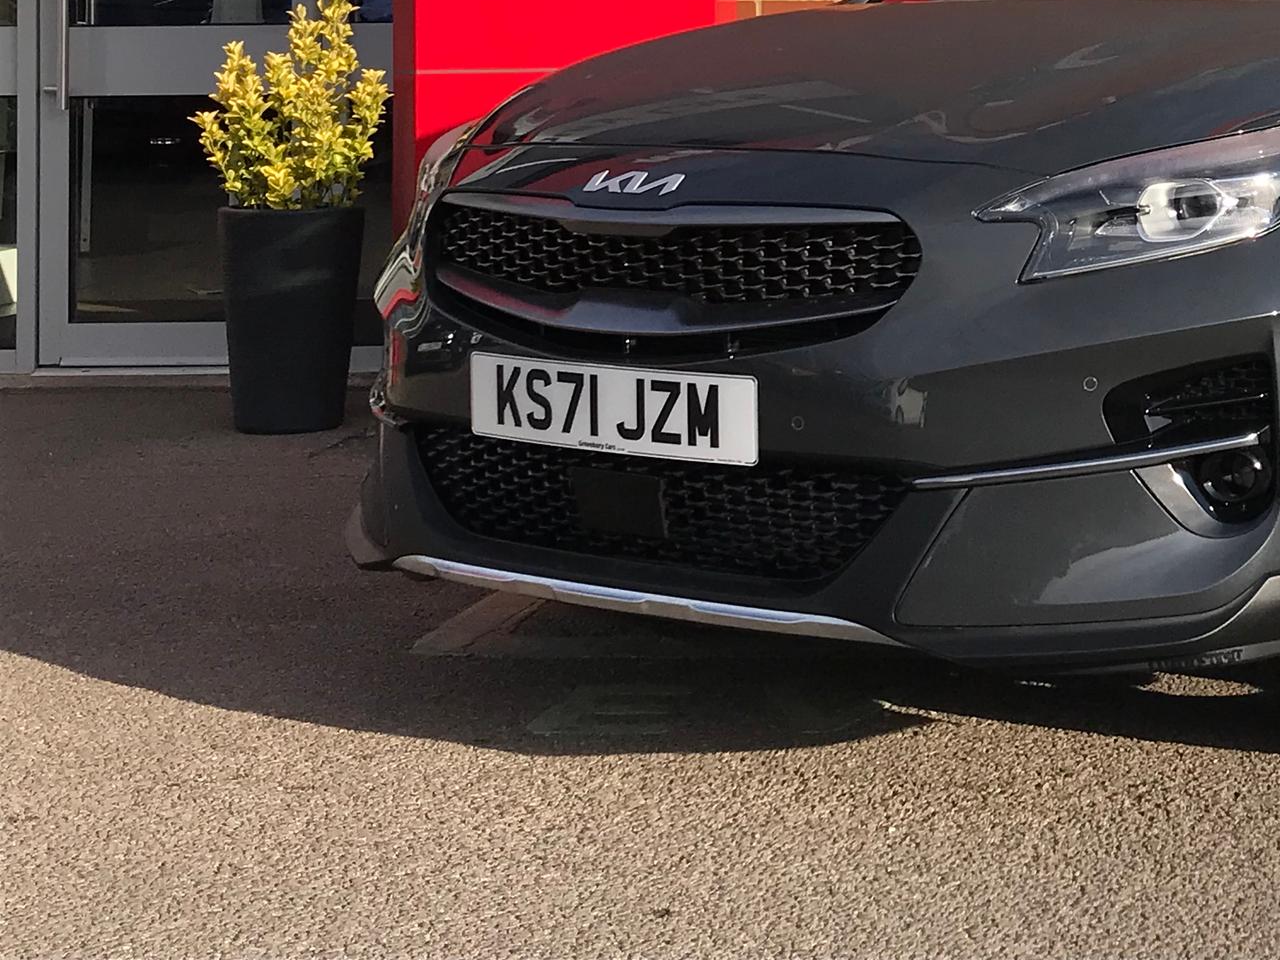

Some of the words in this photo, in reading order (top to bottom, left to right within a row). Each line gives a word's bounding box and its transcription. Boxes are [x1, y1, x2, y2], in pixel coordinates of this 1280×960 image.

[582, 169, 686, 196] KIA
[496, 363, 599, 437] KS71
[616, 377, 720, 449] JZM
